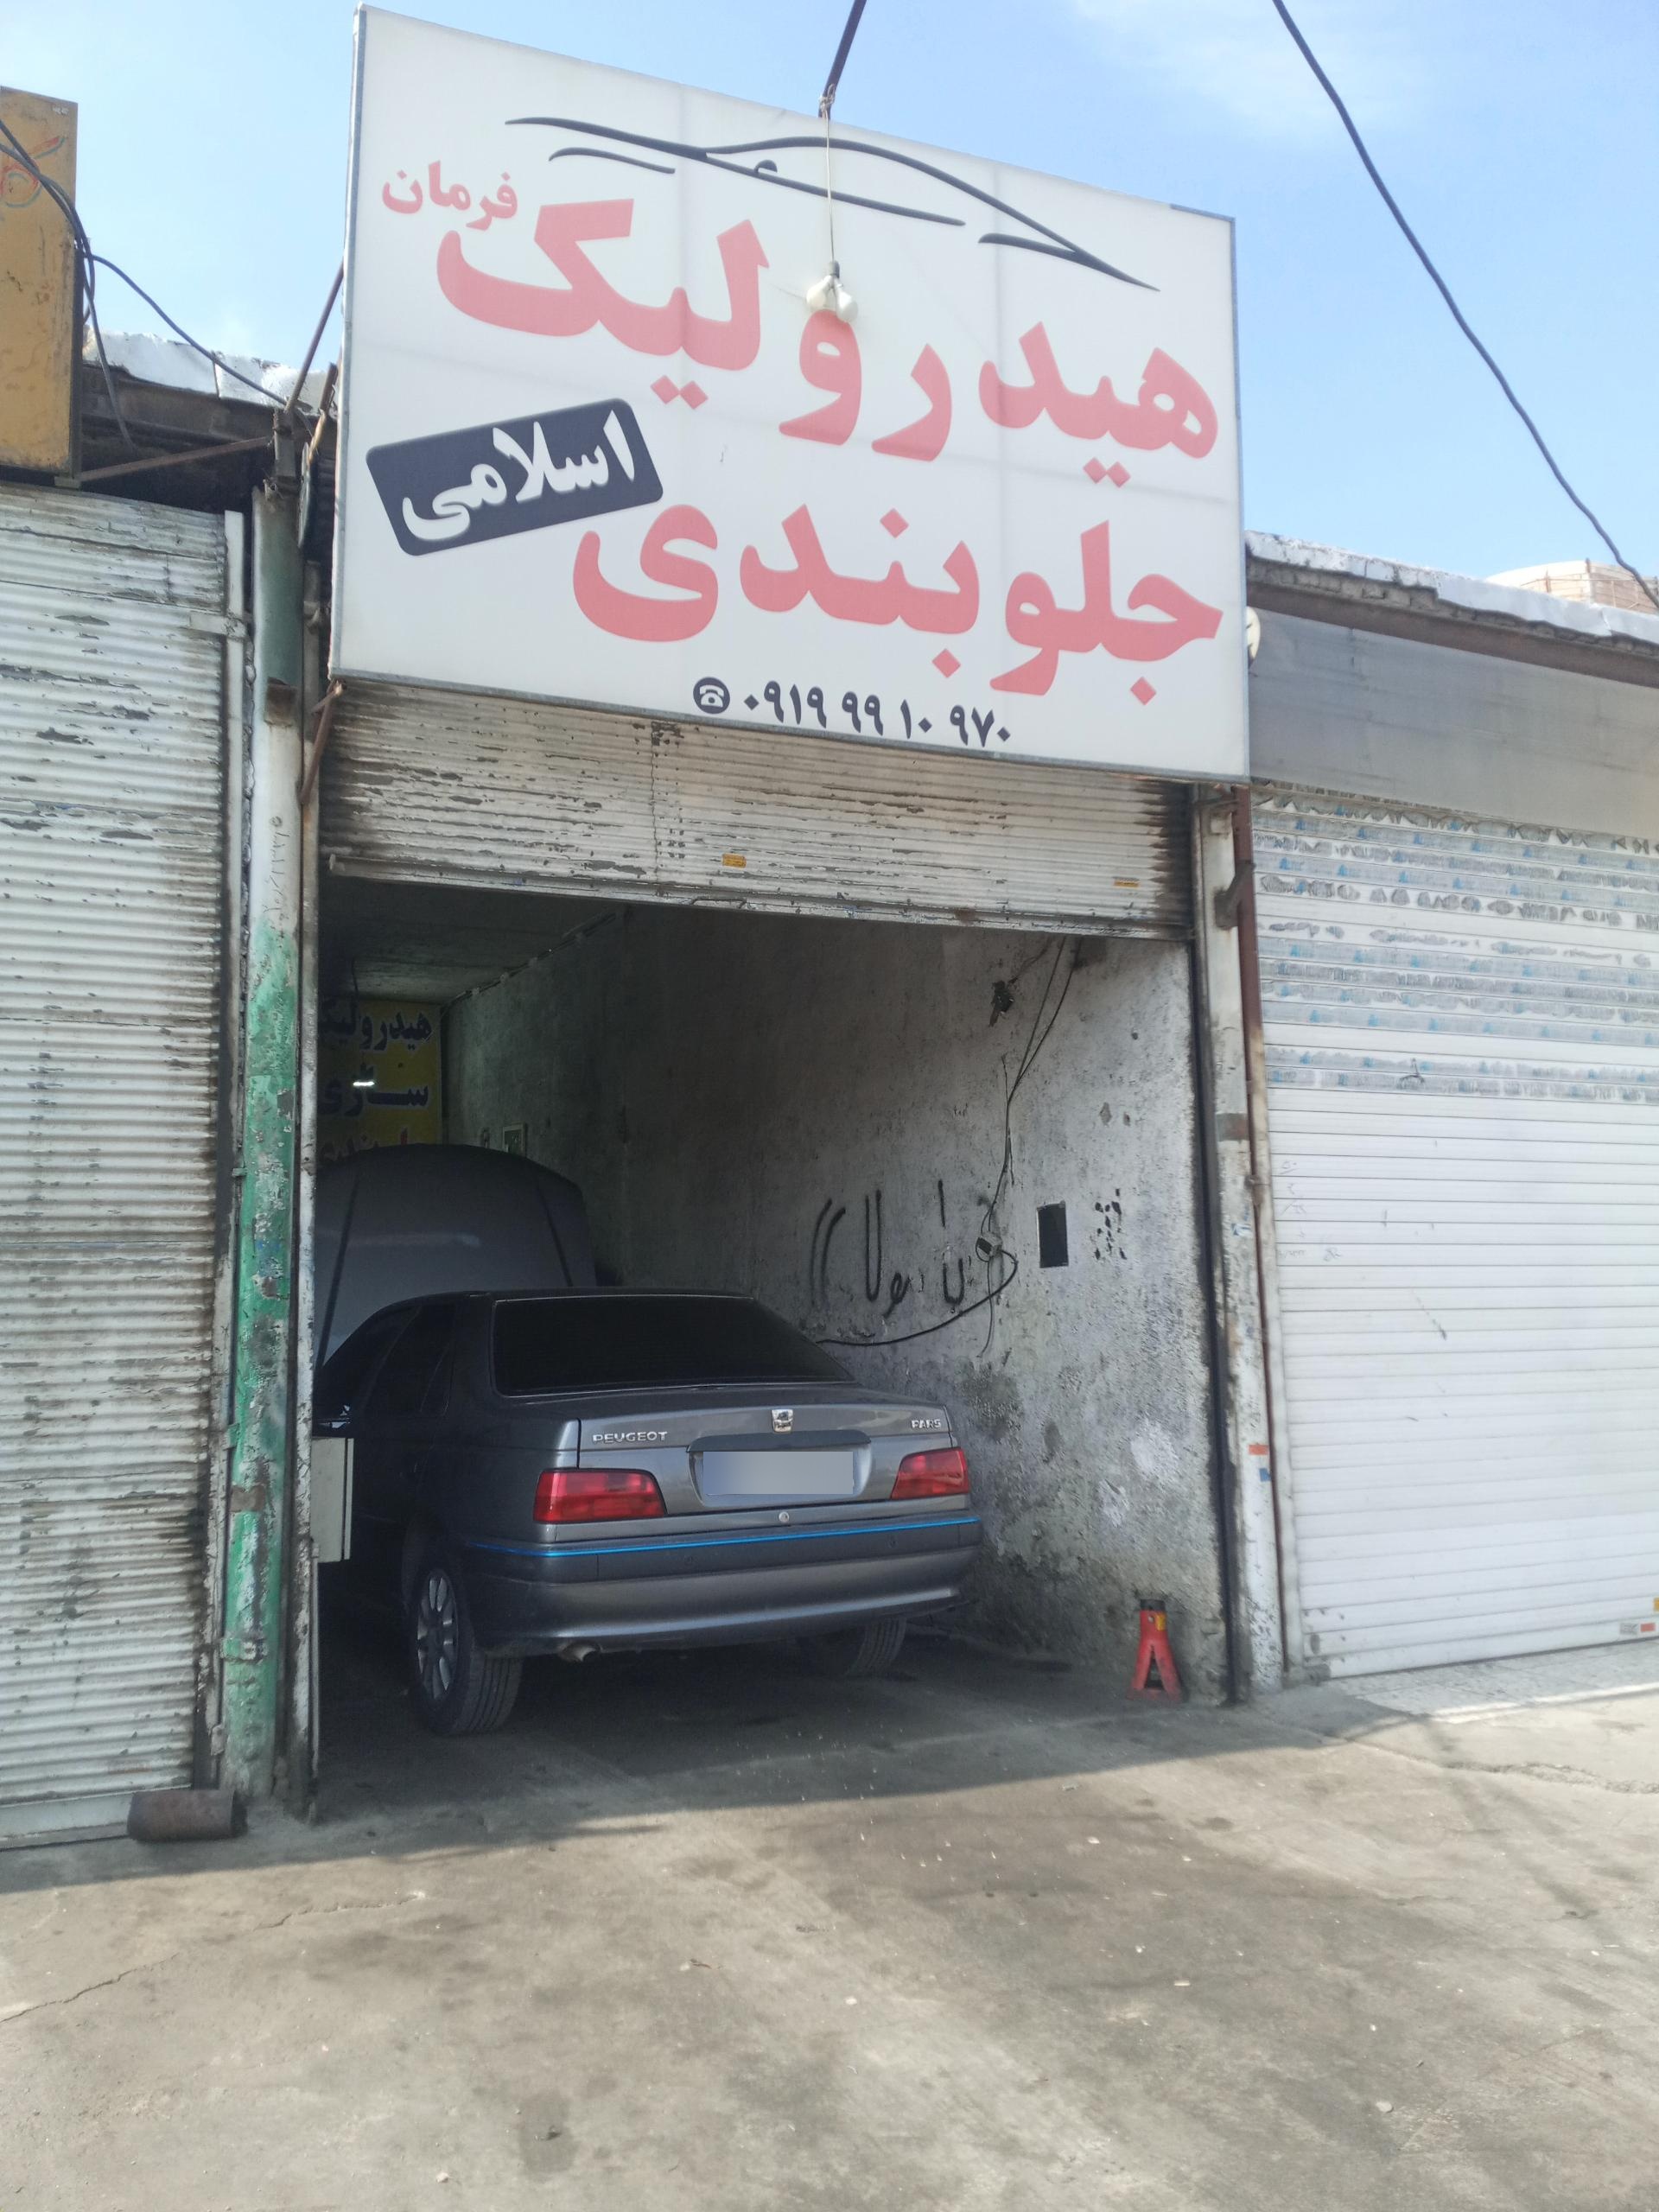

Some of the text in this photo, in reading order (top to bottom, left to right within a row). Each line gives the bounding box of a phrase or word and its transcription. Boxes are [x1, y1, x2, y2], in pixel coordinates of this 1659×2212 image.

[382, 162, 518, 230] فرمان
[437, 200, 1218, 486] هیدرولیک
[402, 410, 635, 540] اسلامی
[572, 505, 1223, 706] جلوبندی
[592, 1431, 669, 1444] PEUGEOT
[911, 1418, 942, 1430] PARS
